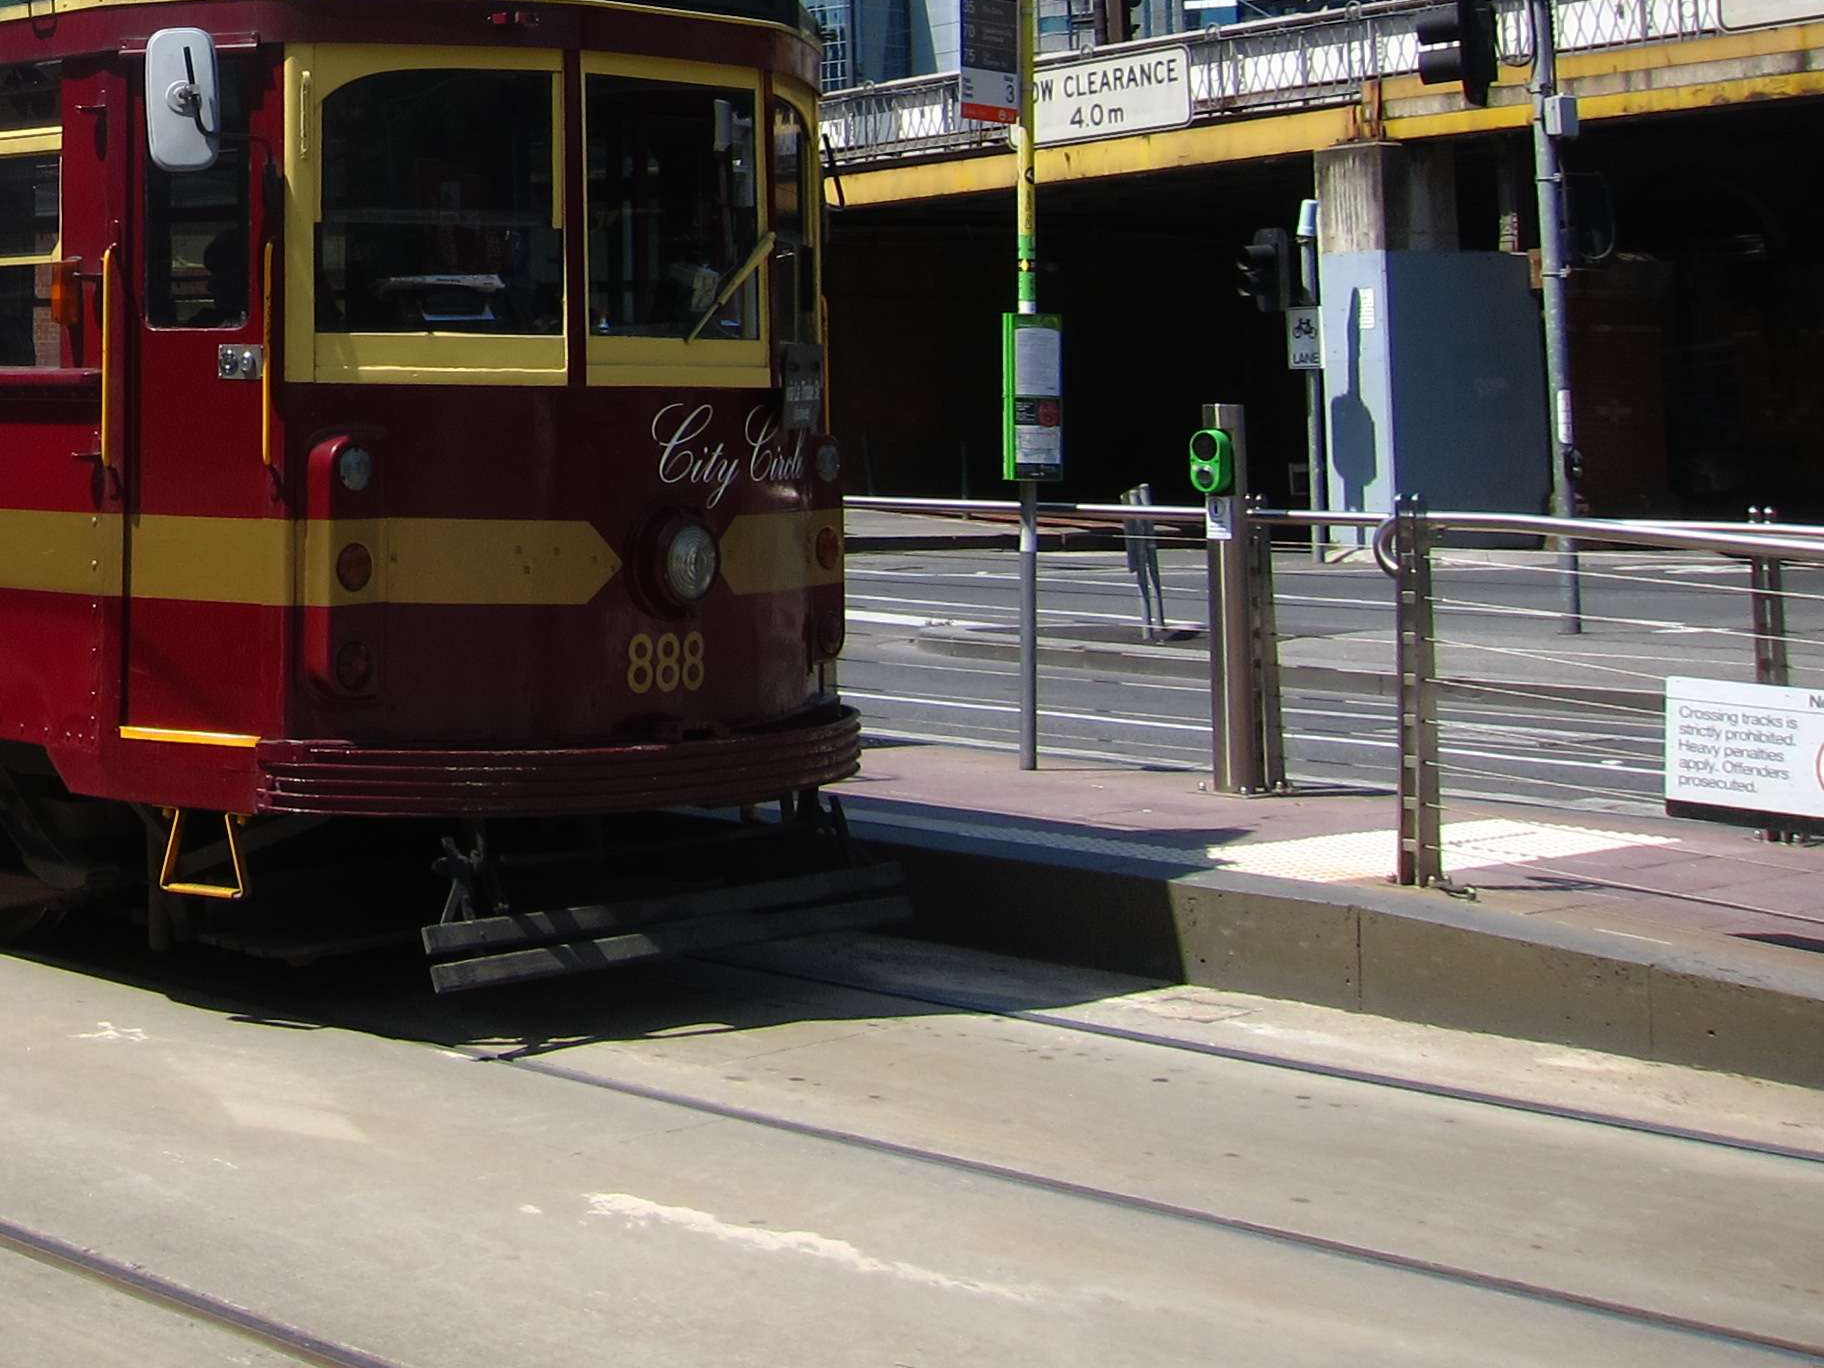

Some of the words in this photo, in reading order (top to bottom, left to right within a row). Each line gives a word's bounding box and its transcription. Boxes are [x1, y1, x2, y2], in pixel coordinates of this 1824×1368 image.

[1032, 79, 1054, 103] OW
[1063, 59, 1179, 98] CLEARANCE
[1005, 85, 1015, 103] 3
[1293, 352, 1320, 364] LANE
[651, 403, 739, 509] City
[627, 632, 705, 694] 888
[1679, 705, 1738, 725] Crossing
[1742, 713, 1783, 729] tracks
[1786, 716, 1798, 730] is
[1679, 723, 1722, 740] strictly
[1725, 728, 1796, 747] prohibited.
[1679, 739, 1720, 757] Heavy
[1724, 745, 1785, 762] penalties
[1678, 757, 1719, 774] apply.
[1722, 760, 1790, 780] Offenders
[1678, 775, 1759, 793] prosecuted.
